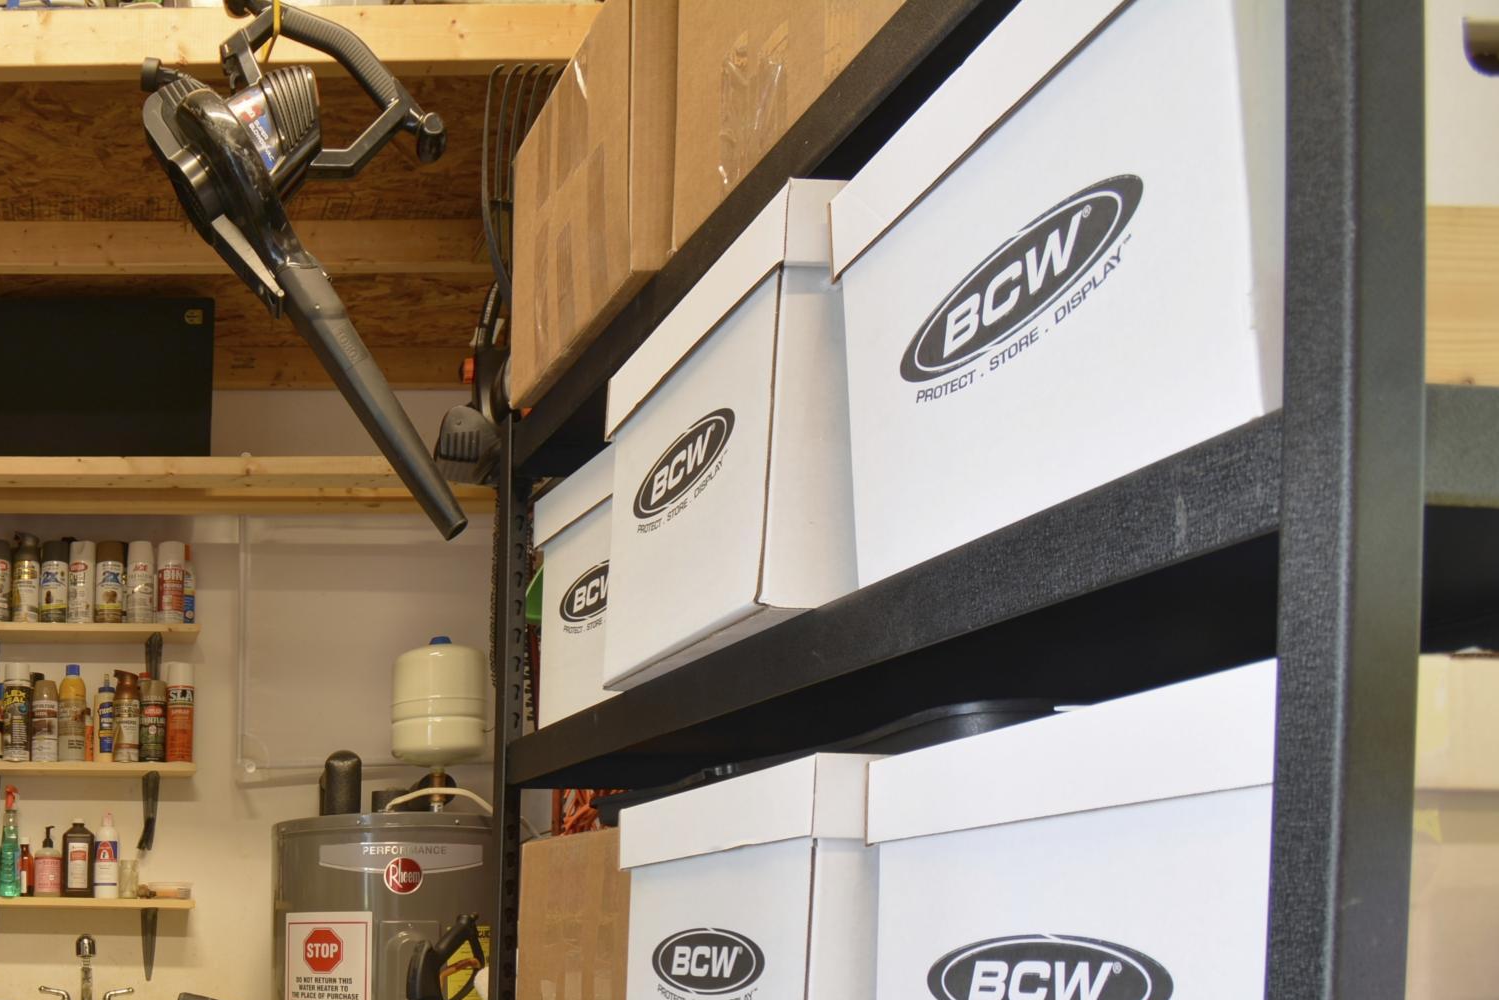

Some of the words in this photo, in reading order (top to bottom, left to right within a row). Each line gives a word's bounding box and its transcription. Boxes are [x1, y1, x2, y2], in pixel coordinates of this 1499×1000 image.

[943, 212, 1084, 358] BCW
[916, 369, 978, 404] PROTECT
[989, 327, 1039, 371] STORE
[1053, 243, 1124, 326] DISPLAY
[650, 426, 712, 506] BCW
[667, 498, 688, 521] STORE
[389, 859, 420, 888] Rheem
[307, 943, 338, 958] STOP
[671, 946, 740, 978] BCW
